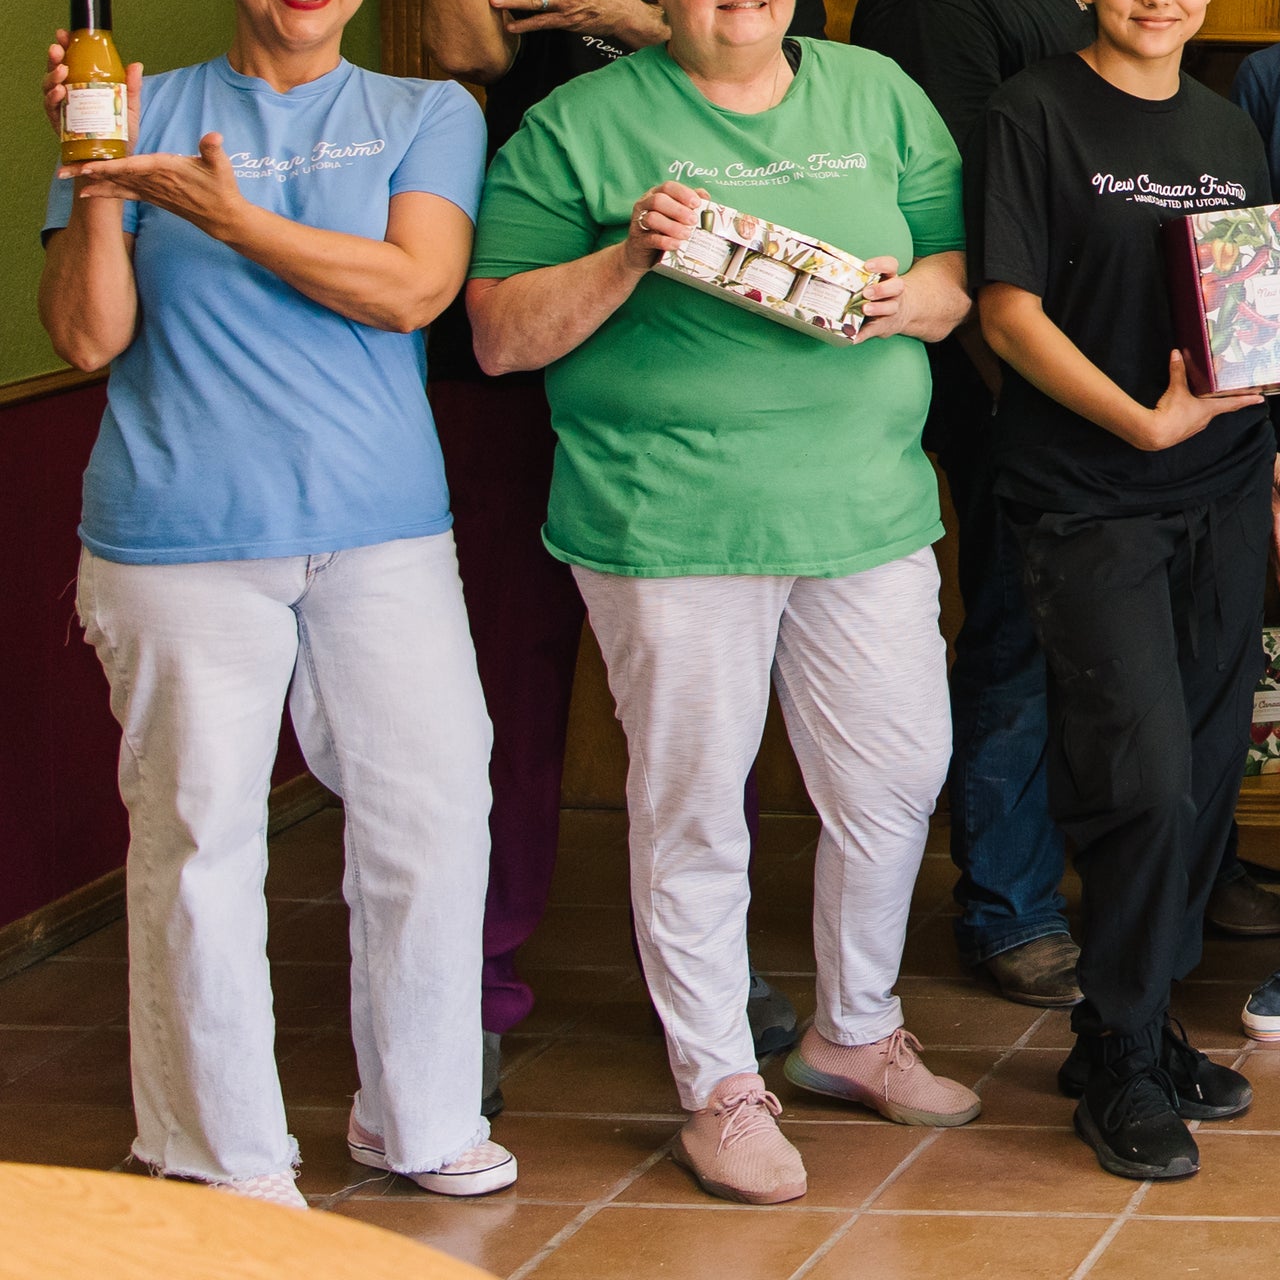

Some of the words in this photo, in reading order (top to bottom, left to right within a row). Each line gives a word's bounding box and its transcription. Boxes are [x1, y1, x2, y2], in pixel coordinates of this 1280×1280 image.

[582, 36, 623, 55] New
[311, 139, 386, 163] Farms
[668, 160, 718, 181] New
[807, 153, 868, 170] Farms
[716, 175, 790, 187] HANDCRAFTED
[793, 171, 805, 181] IN
[1092, 173, 1135, 194] New
[1137, 174, 1197, 197] Canaan
[1199, 174, 1247, 201] Farms
[1183, 200, 1194, 209] IN
[1196, 198, 1230, 208] UTOPIA
[1257, 288, 1277, 298] New
